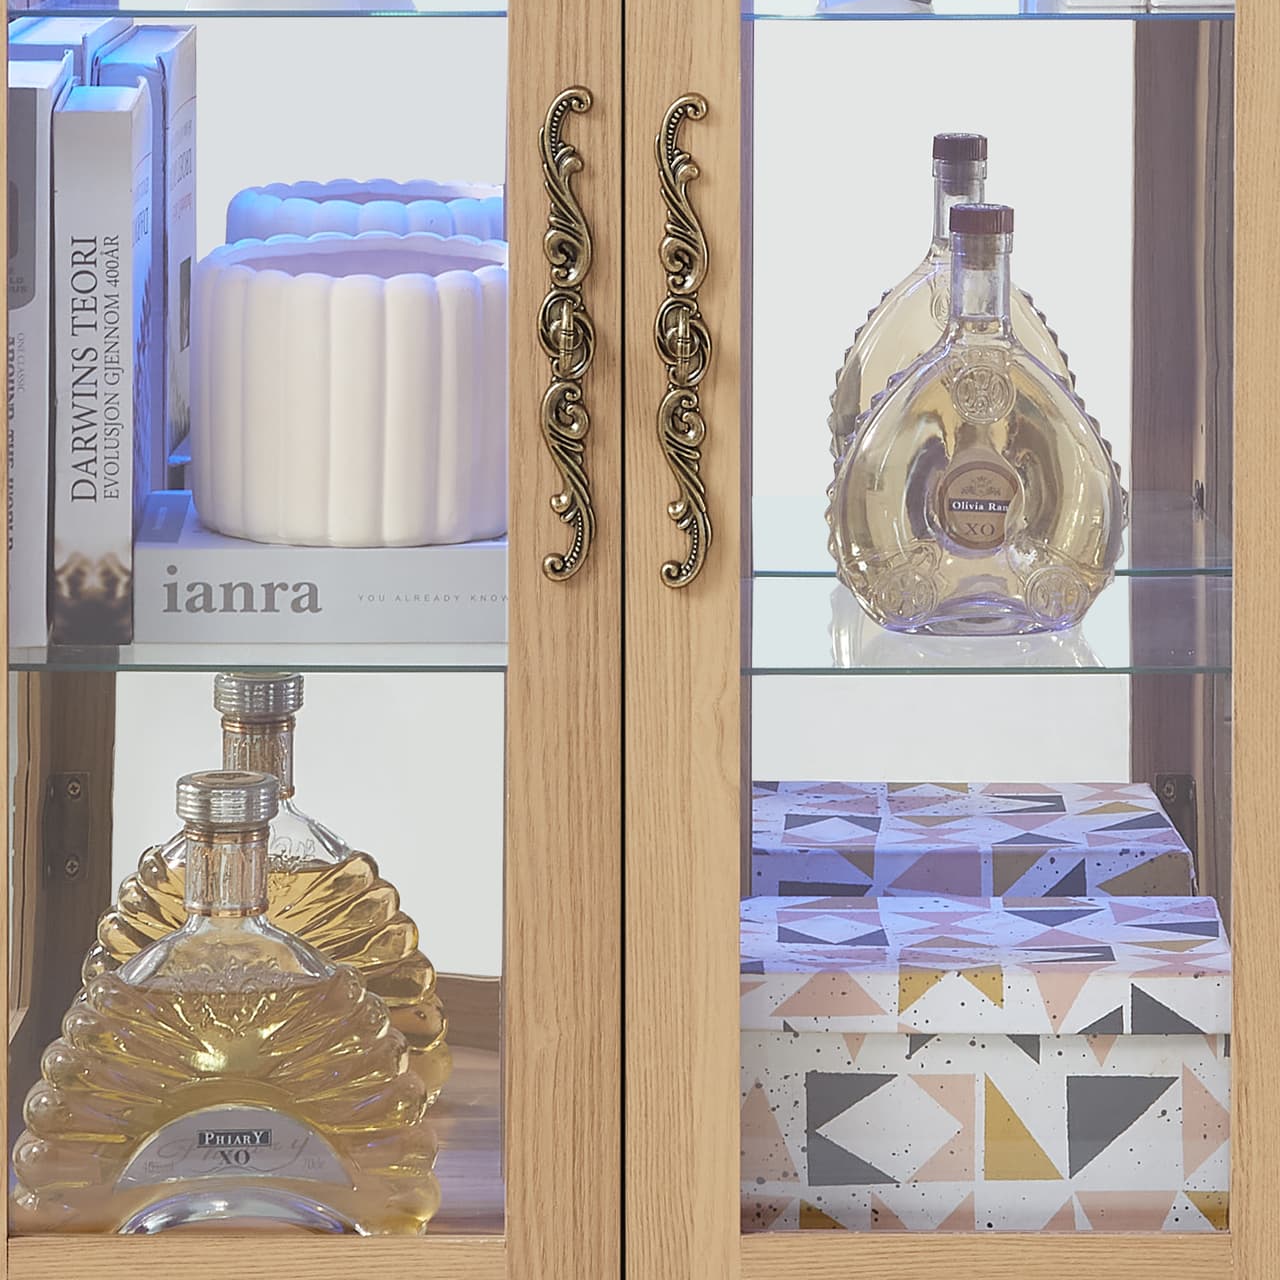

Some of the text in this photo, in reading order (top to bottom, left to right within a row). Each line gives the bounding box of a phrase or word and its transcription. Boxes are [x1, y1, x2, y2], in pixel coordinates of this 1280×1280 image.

[71, 235, 98, 503] DARWINS TEORI
[100, 235, 124, 500] EVOLUSJON GJENNOM 400ÅR
[952, 501, 984, 511] Olivia
[964, 522, 996, 537] XO
[162, 564, 323, 614] ianra
[358, 594, 386, 602] YOU
[394, 594, 460, 602] ALREADY
[219, 1150, 251, 1166] XO
